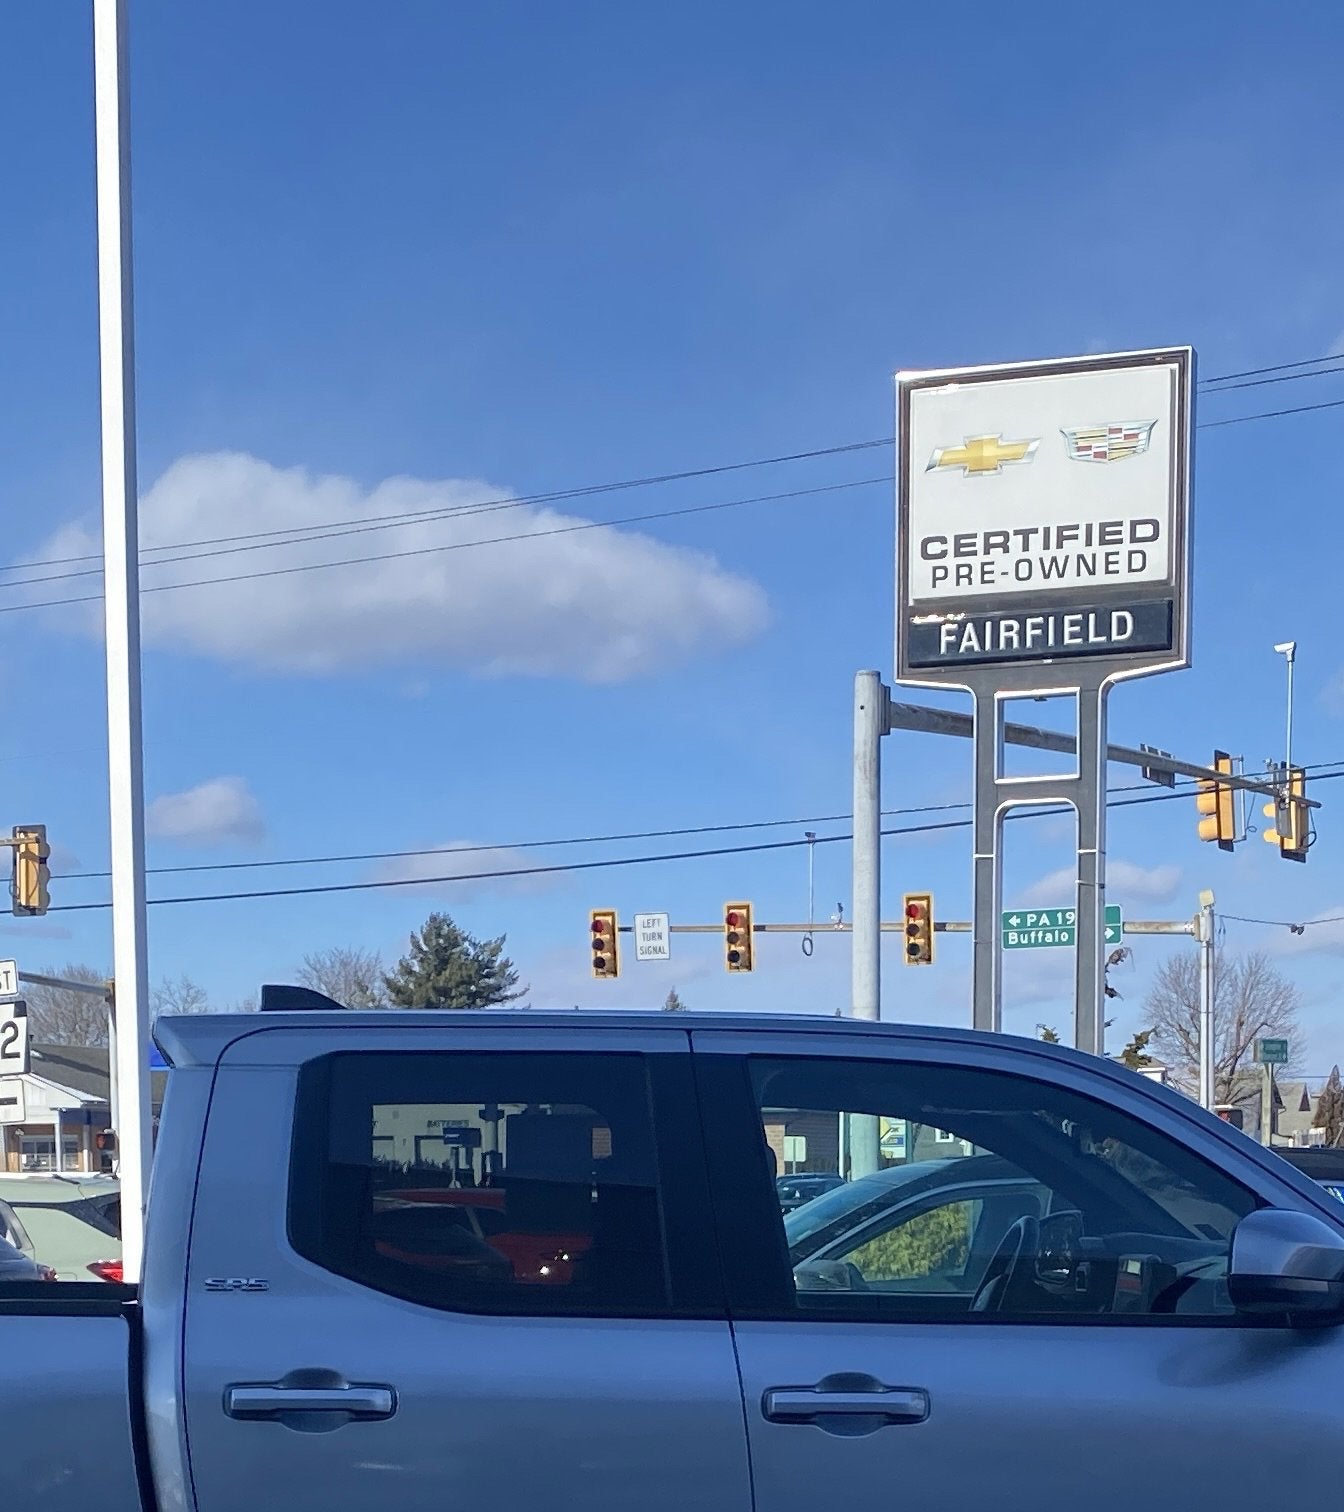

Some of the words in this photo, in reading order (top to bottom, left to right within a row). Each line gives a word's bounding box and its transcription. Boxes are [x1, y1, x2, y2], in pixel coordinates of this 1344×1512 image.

[920, 518, 1160, 561] CERTIFIED
[931, 549, 1147, 589] PRE-OWNED
[939, 610, 1135, 655] FAIRFIELD
[642, 918, 661, 929] LEFT
[1026, 913, 1051, 926] PA
[1056, 911, 1075, 925] 19
[641, 931, 663, 942] TURN
[1008, 930, 1069, 945] Buffalo
[639, 945, 667, 956] SIGNAL
